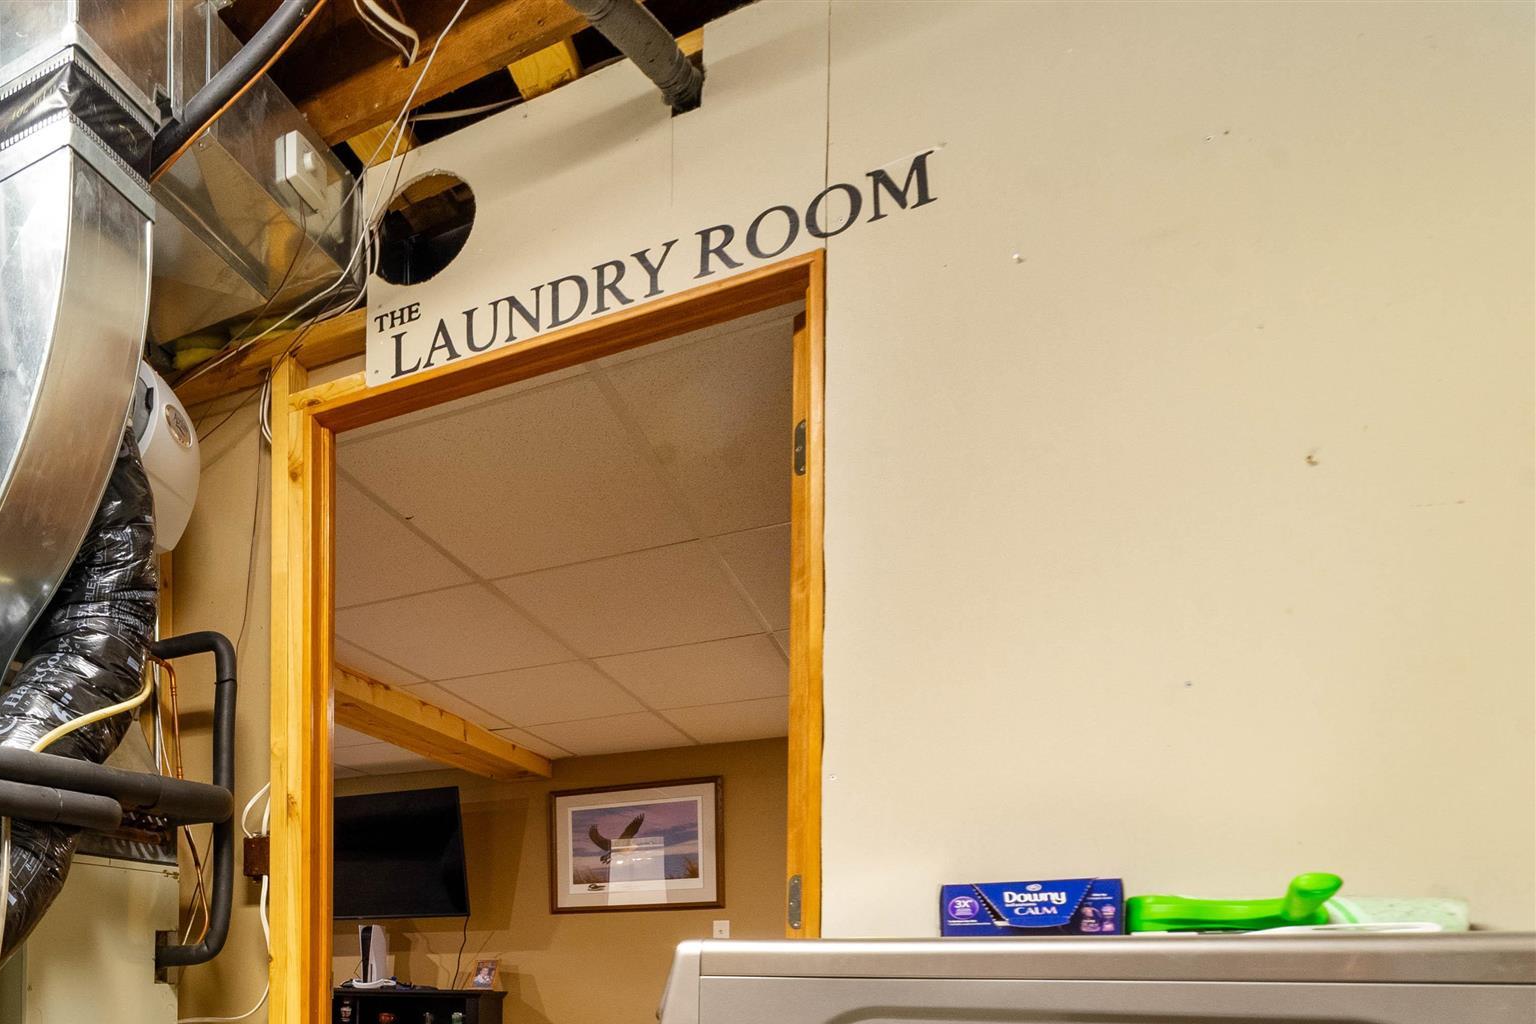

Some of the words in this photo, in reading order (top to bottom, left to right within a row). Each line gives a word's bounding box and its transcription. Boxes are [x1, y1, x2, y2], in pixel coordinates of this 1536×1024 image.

[390, 239, 678, 379] LAUNDRY
[694, 150, 939, 280] ROOM
[374, 302, 421, 333] THE
[1003, 890, 1067, 904] Downy
[1014, 906, 1059, 915] CALM
